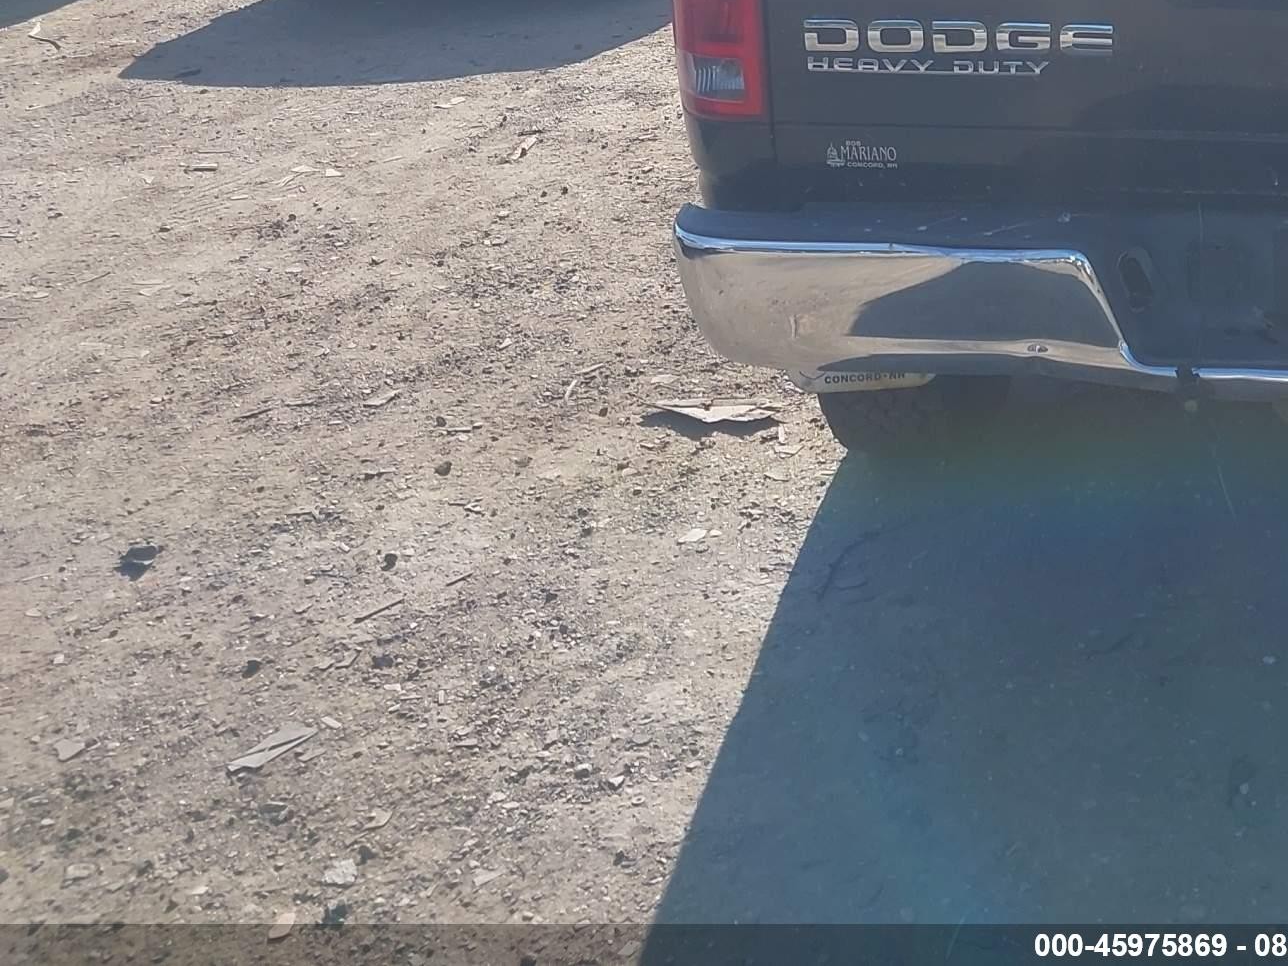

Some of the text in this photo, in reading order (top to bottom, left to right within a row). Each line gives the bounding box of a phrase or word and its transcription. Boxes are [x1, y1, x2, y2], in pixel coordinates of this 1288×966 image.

[804, 19, 1113, 53] DODGE
[807, 56, 1049, 74] HEAVY DUTY
[840, 145, 897, 162] MARIANO
